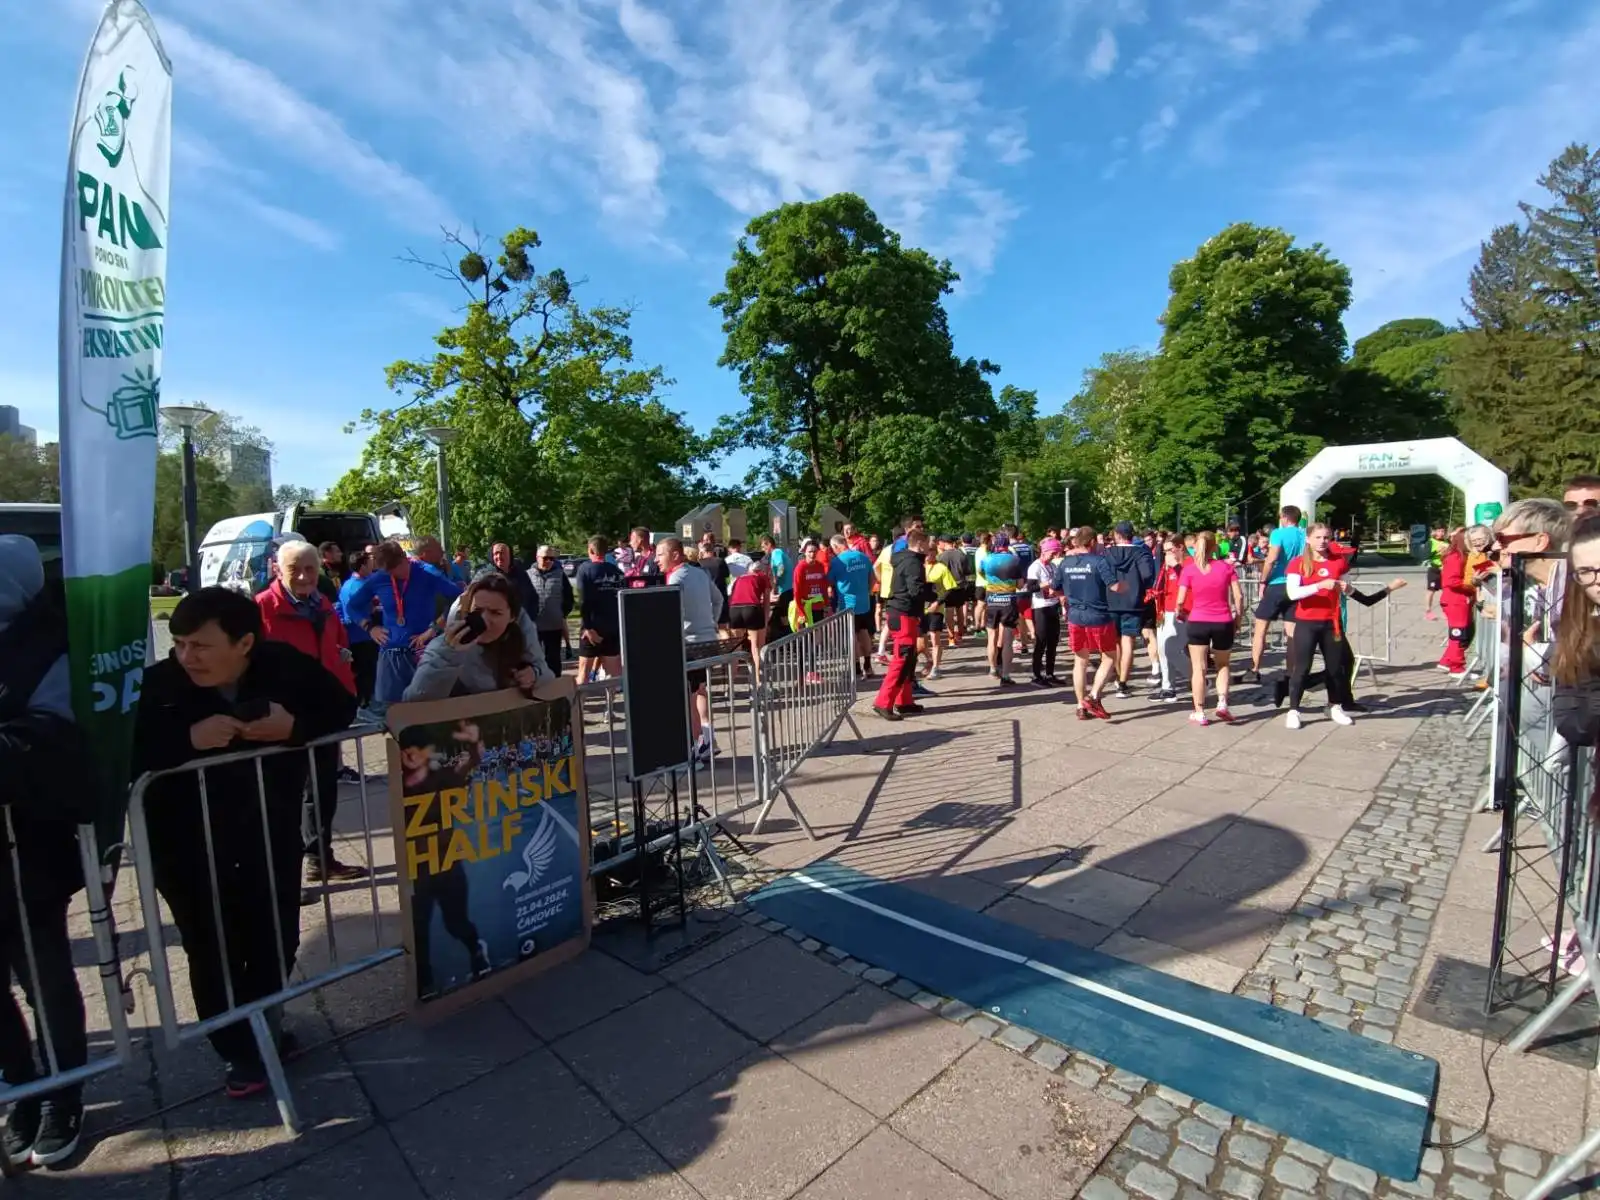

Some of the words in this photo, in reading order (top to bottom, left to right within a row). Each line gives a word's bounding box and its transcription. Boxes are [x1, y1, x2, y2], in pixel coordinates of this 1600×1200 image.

[78, 170, 163, 250] PAN
[404, 756, 577, 837] ZRINSKI
[406, 812, 522, 880] HALF
